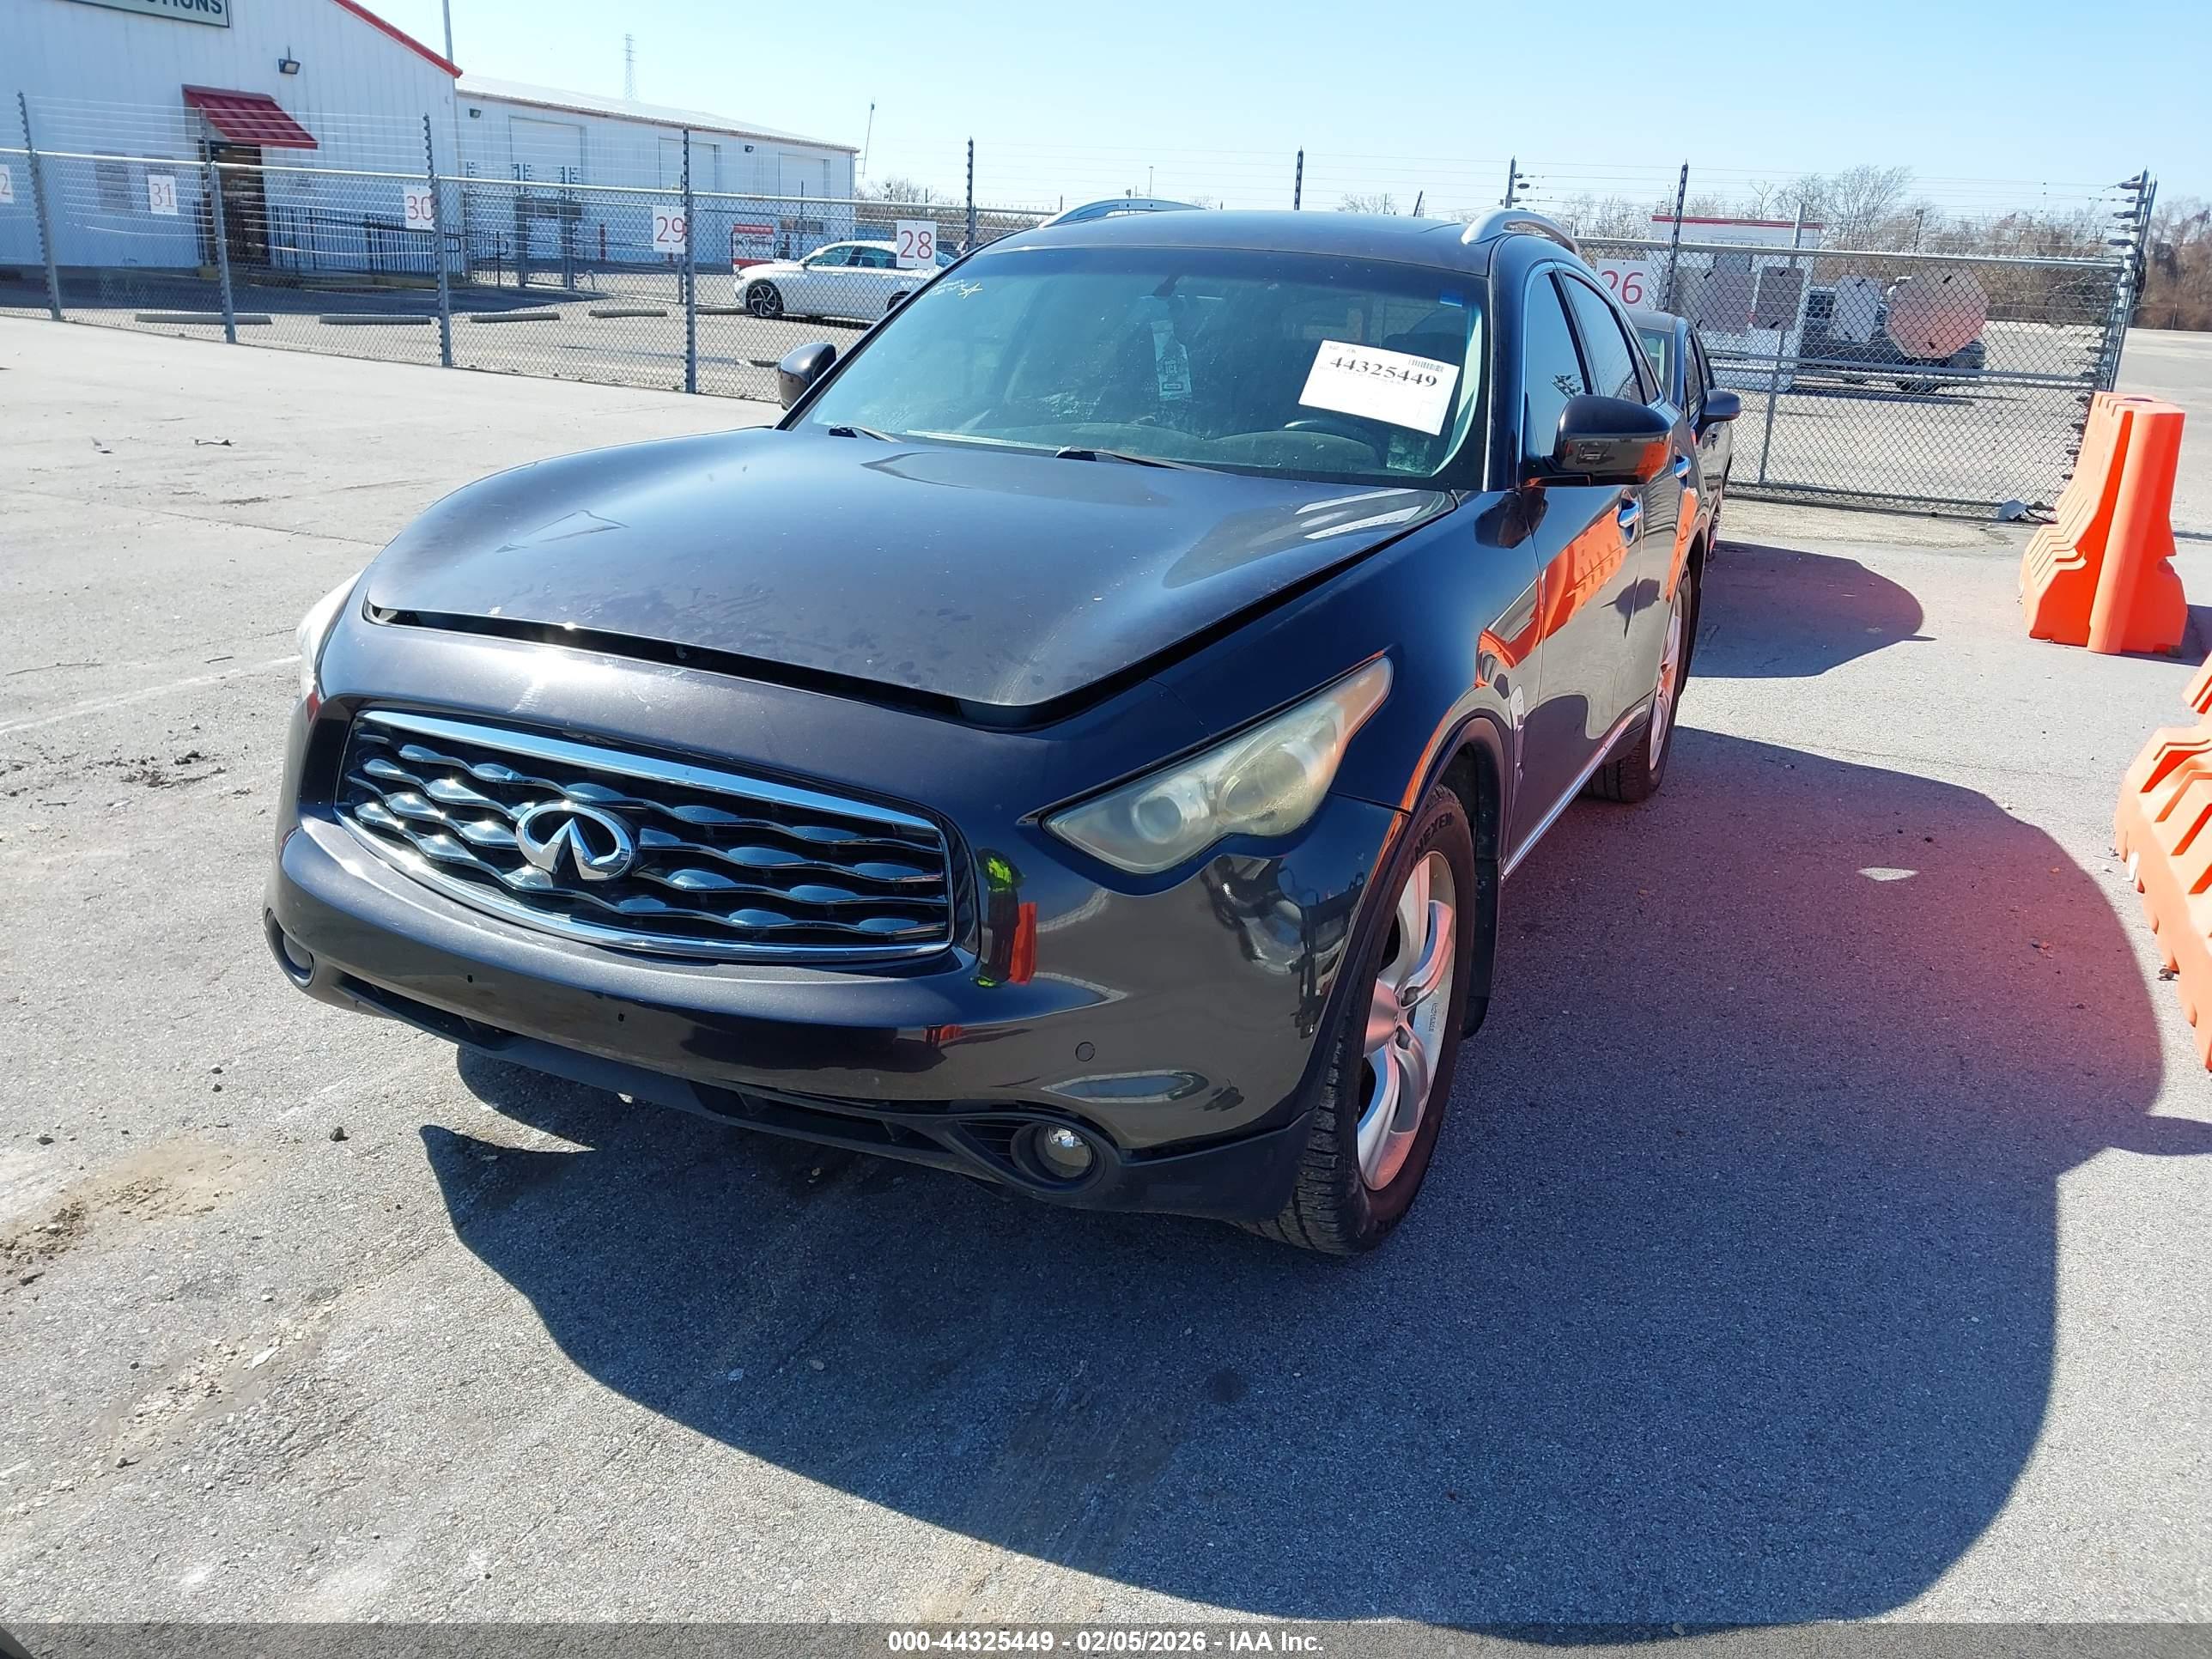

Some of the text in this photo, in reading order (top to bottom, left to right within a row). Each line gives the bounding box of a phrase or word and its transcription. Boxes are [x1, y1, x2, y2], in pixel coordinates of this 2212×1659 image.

[152, 182, 175, 207] 31
[406, 194, 434, 221] 30
[656, 216, 685, 243] 29
[899, 229, 934, 259] 28
[1329, 356, 1438, 387] 44325449
